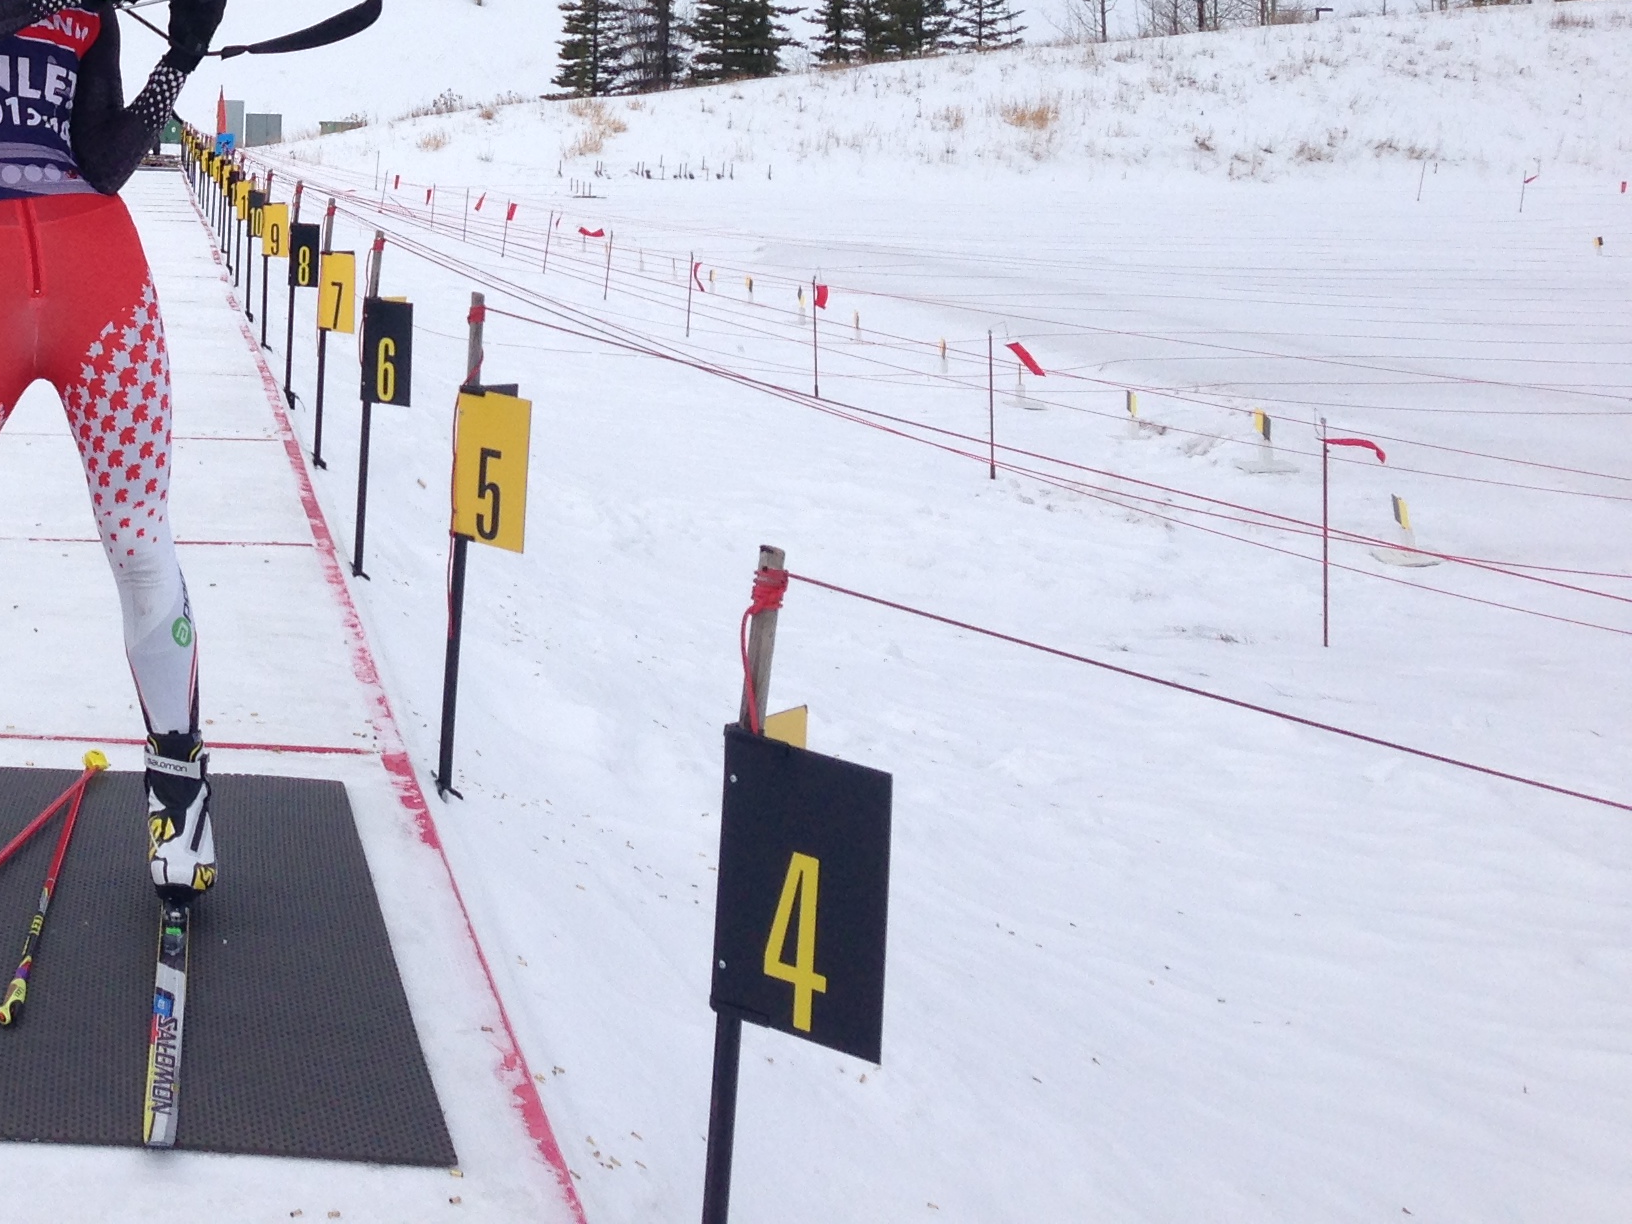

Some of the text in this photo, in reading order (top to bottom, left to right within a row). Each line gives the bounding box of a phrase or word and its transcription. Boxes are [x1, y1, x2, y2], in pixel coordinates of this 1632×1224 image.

[250, 207, 263, 236] 10
[270, 222, 280, 256] 9
[298, 246, 310, 287] 8
[331, 281, 344, 331] 7
[376, 337, 396, 402] 6
[476, 447, 502, 541] 5
[147, 757, 188, 773] salomon
[762, 852, 827, 1033] 4
[151, 1015, 178, 1116] SALOMON
